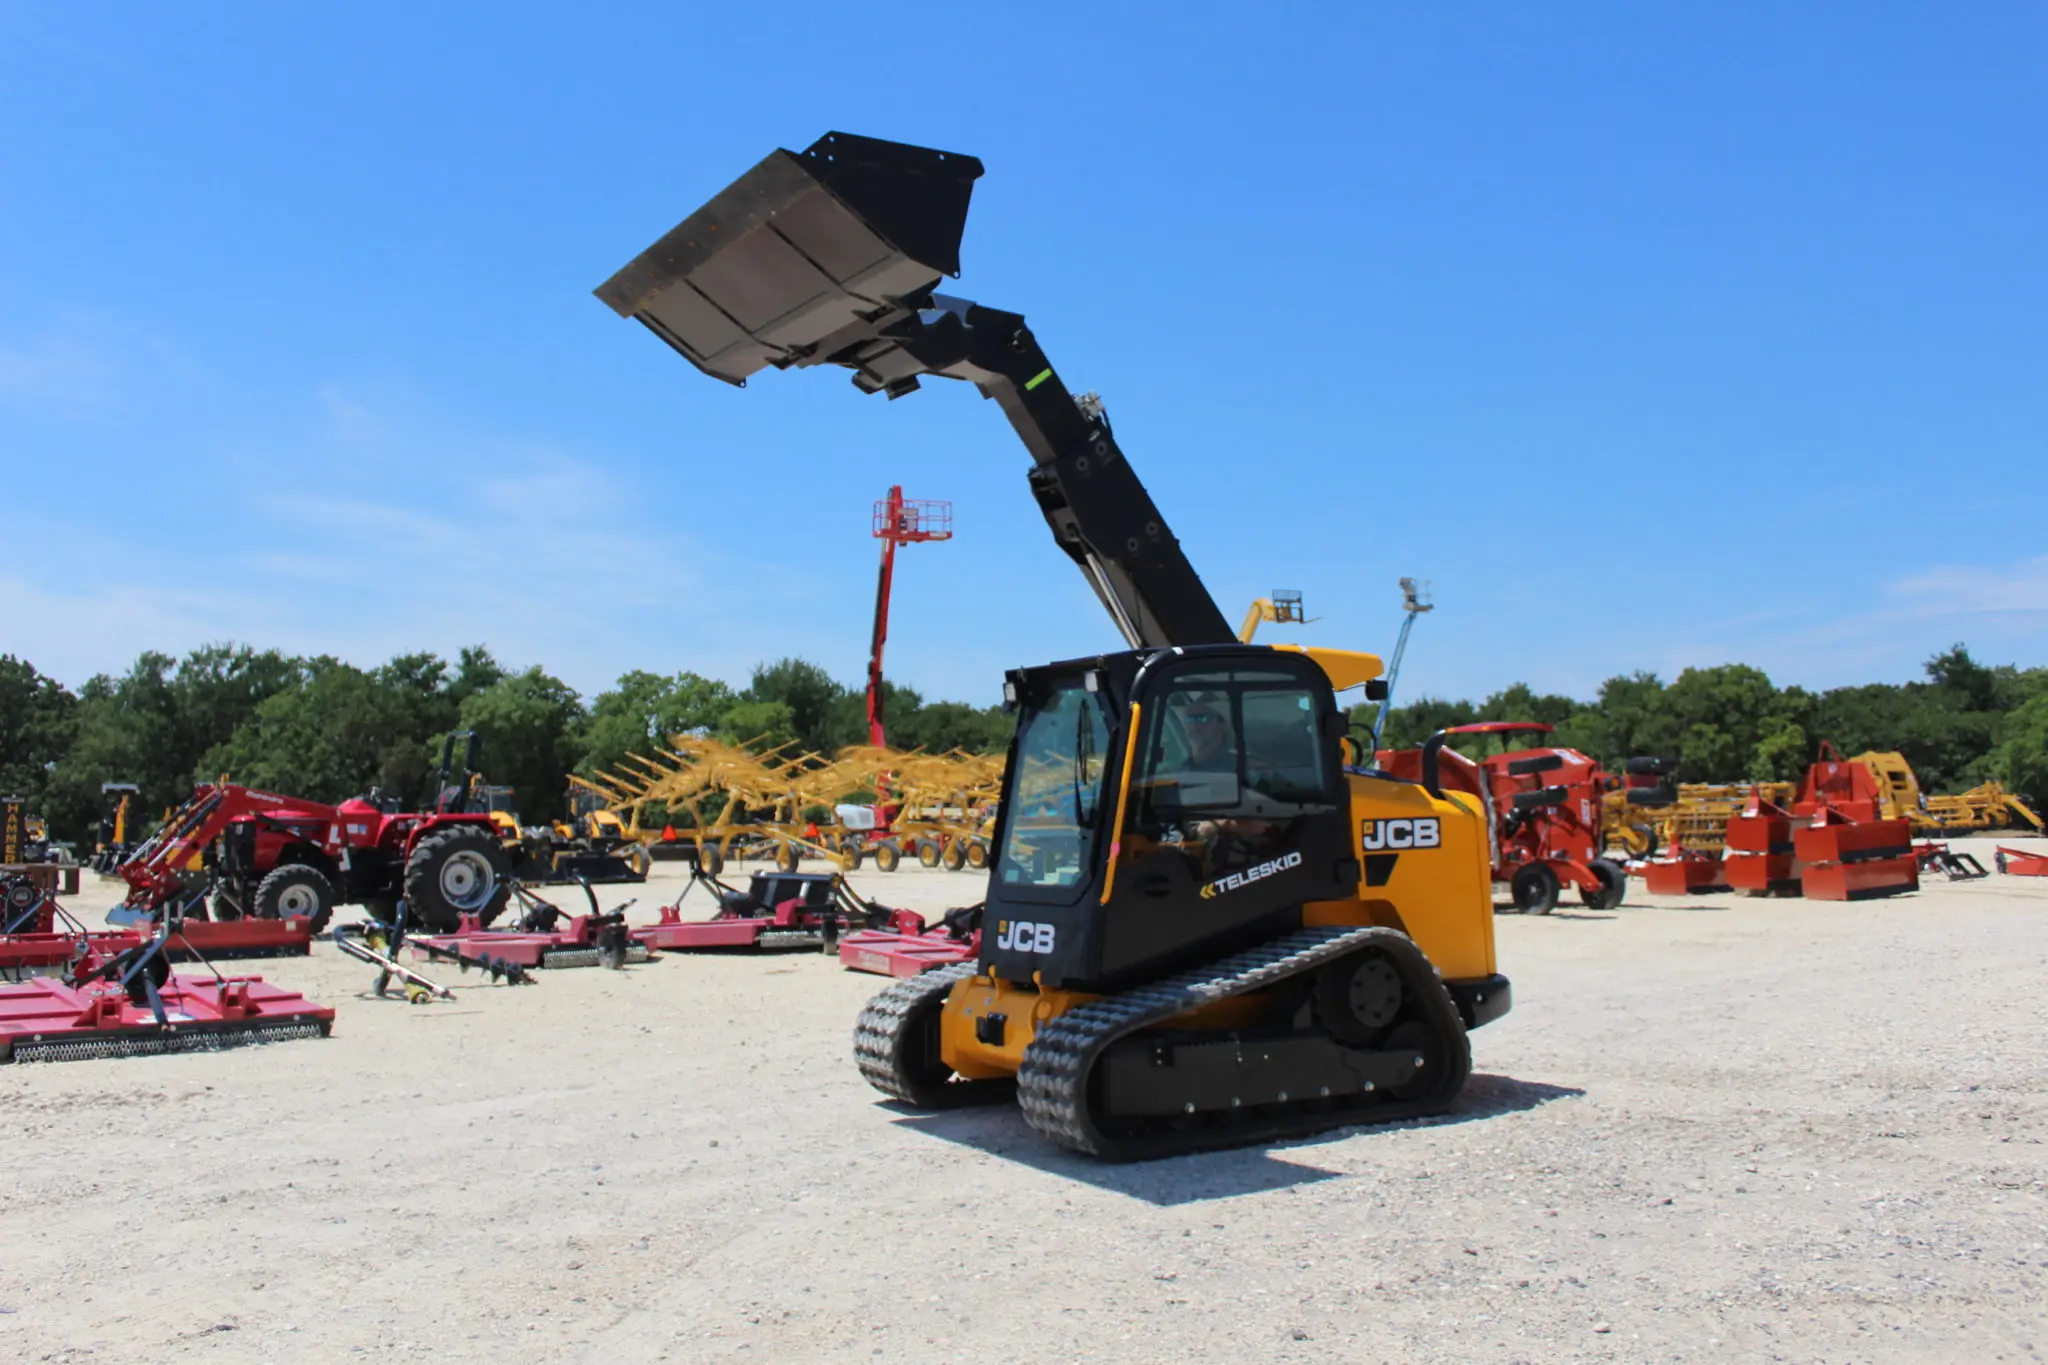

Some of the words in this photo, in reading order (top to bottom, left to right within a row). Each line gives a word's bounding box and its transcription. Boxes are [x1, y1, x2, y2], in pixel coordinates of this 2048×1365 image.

[5, 803, 19, 864] HAMMER
[1363, 819, 1440, 849] JCB
[1214, 851, 1302, 893] TELESKID
[997, 920, 1055, 954] JCB
